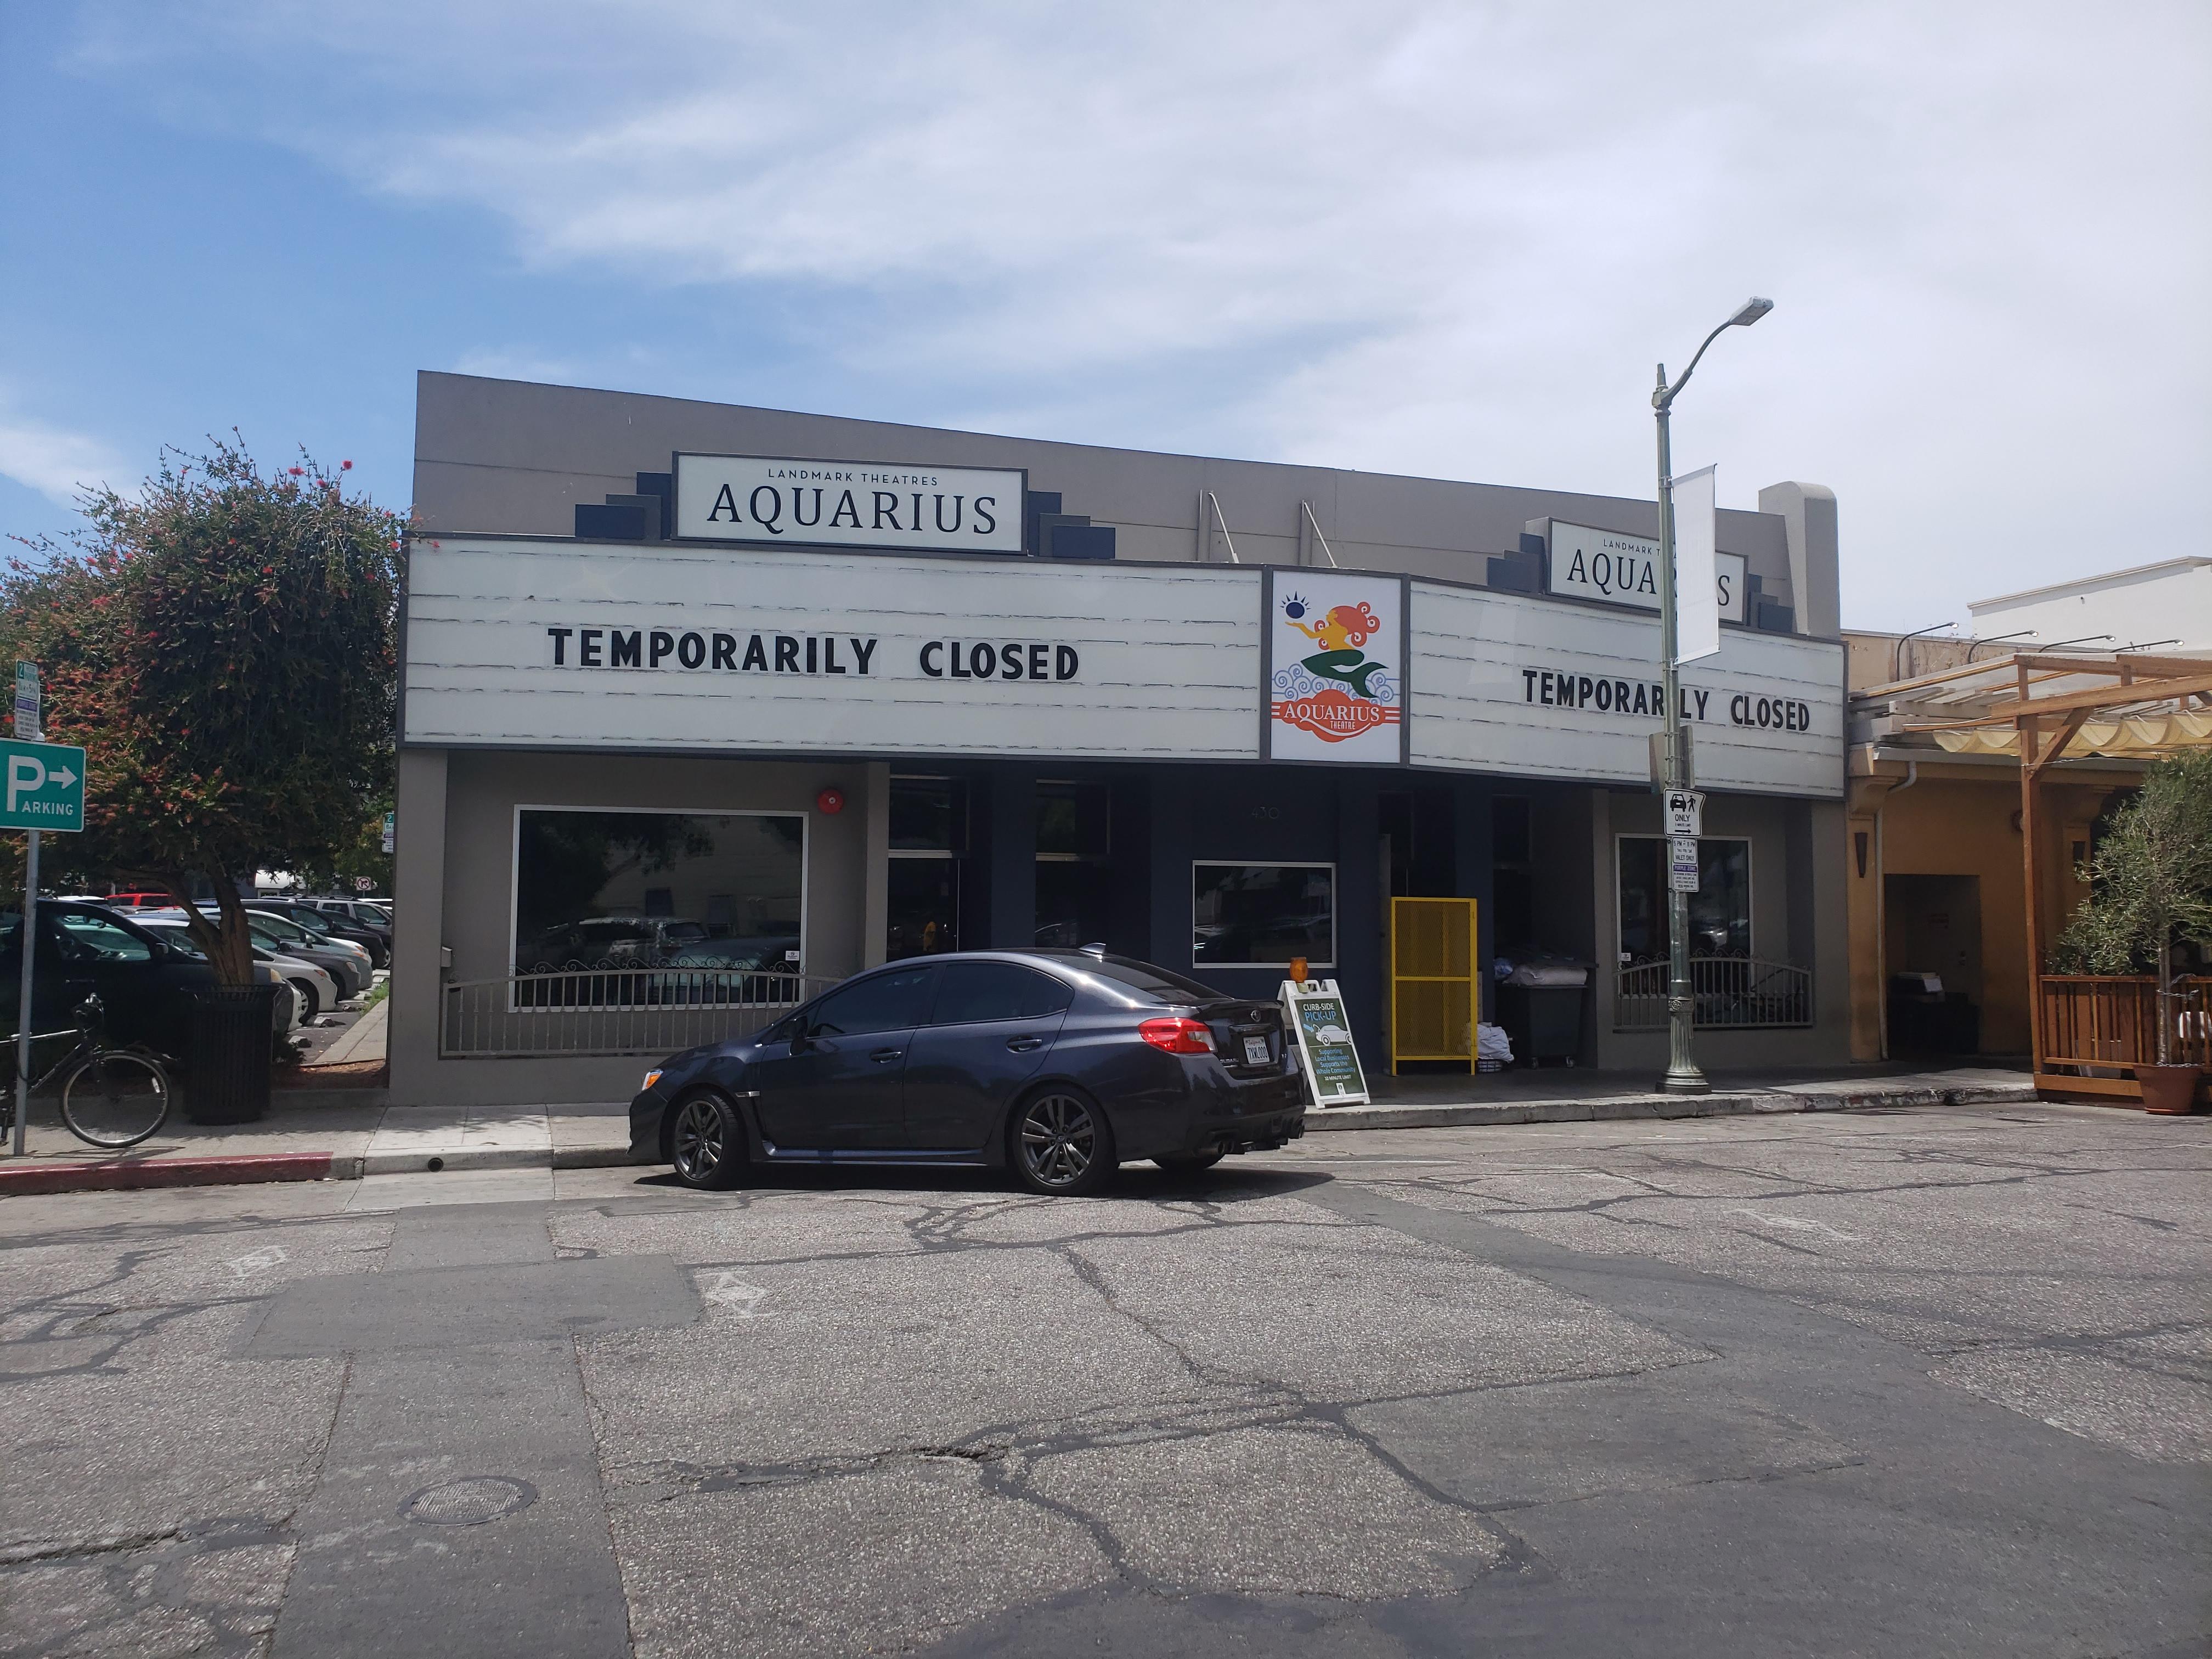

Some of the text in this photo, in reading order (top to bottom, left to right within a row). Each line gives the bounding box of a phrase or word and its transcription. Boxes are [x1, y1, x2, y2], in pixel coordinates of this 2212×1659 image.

[768, 467, 939, 487] LANDMARK THEATRES
[706, 483, 997, 535] AQUARIUS
[1603, 538, 1652, 555] LANDMARK
[1567, 549, 1730, 607] AQUAS
[548, 628, 1079, 681] TEMPORARILY CLOSED
[19, 663, 24, 678] 2
[1522, 669, 1810, 731] TEMPORARLY CLOSED
[1283, 704, 1380, 723] AQUARIUS
[1330, 720, 1356, 730] THEATRE
[1675, 814, 1690, 822] ONLY
[1303, 1002, 1335, 1011] CURB-SIDE
[1305, 1011, 1336, 1022] PICK-UP
